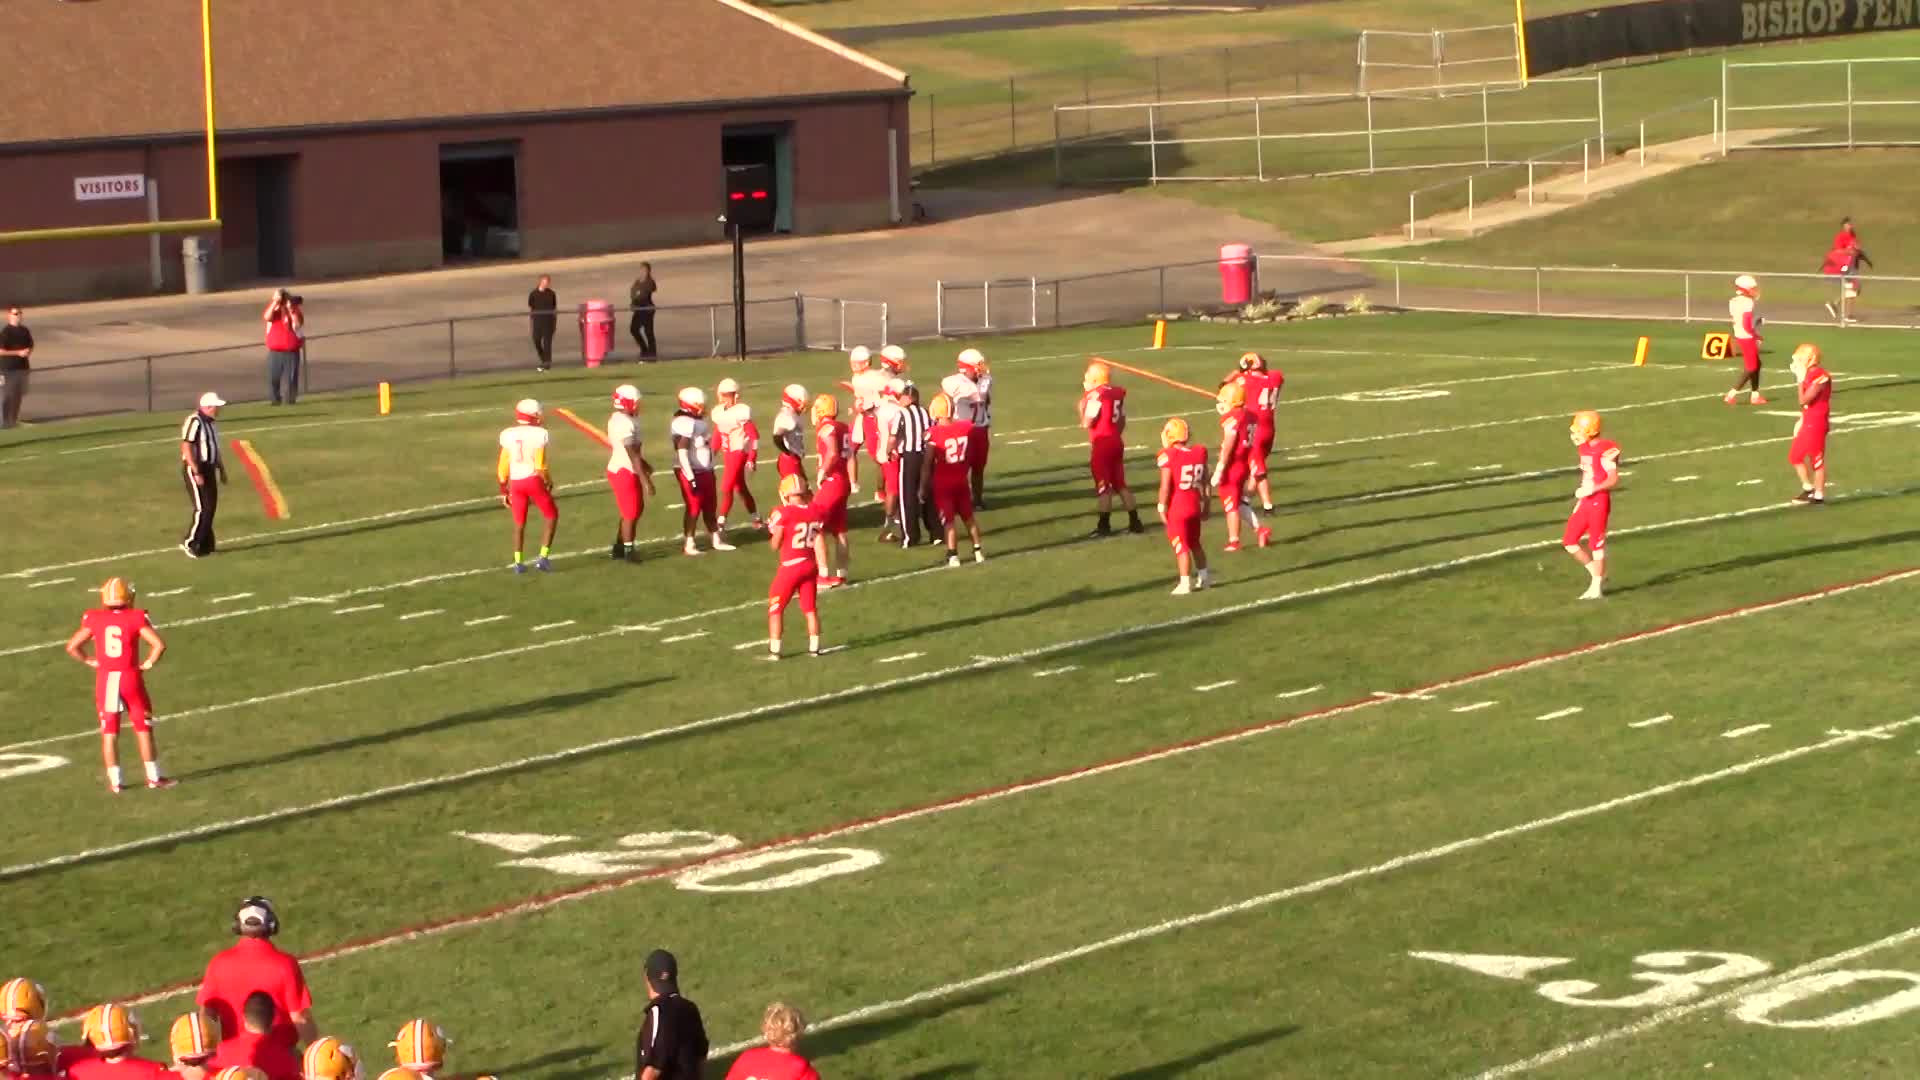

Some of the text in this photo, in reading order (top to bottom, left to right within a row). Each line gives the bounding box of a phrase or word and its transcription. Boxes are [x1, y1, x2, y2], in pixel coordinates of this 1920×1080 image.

[1741, 0, 1920, 40] BISHOP FEN
[80, 179, 140, 194] VISITORS
[1706, 336, 1723, 357] G
[944, 435, 969, 464] 27
[104, 625, 123, 658] 6
[499, 830, 884, 892] 20
[1536, 949, 1920, 1028] 30
